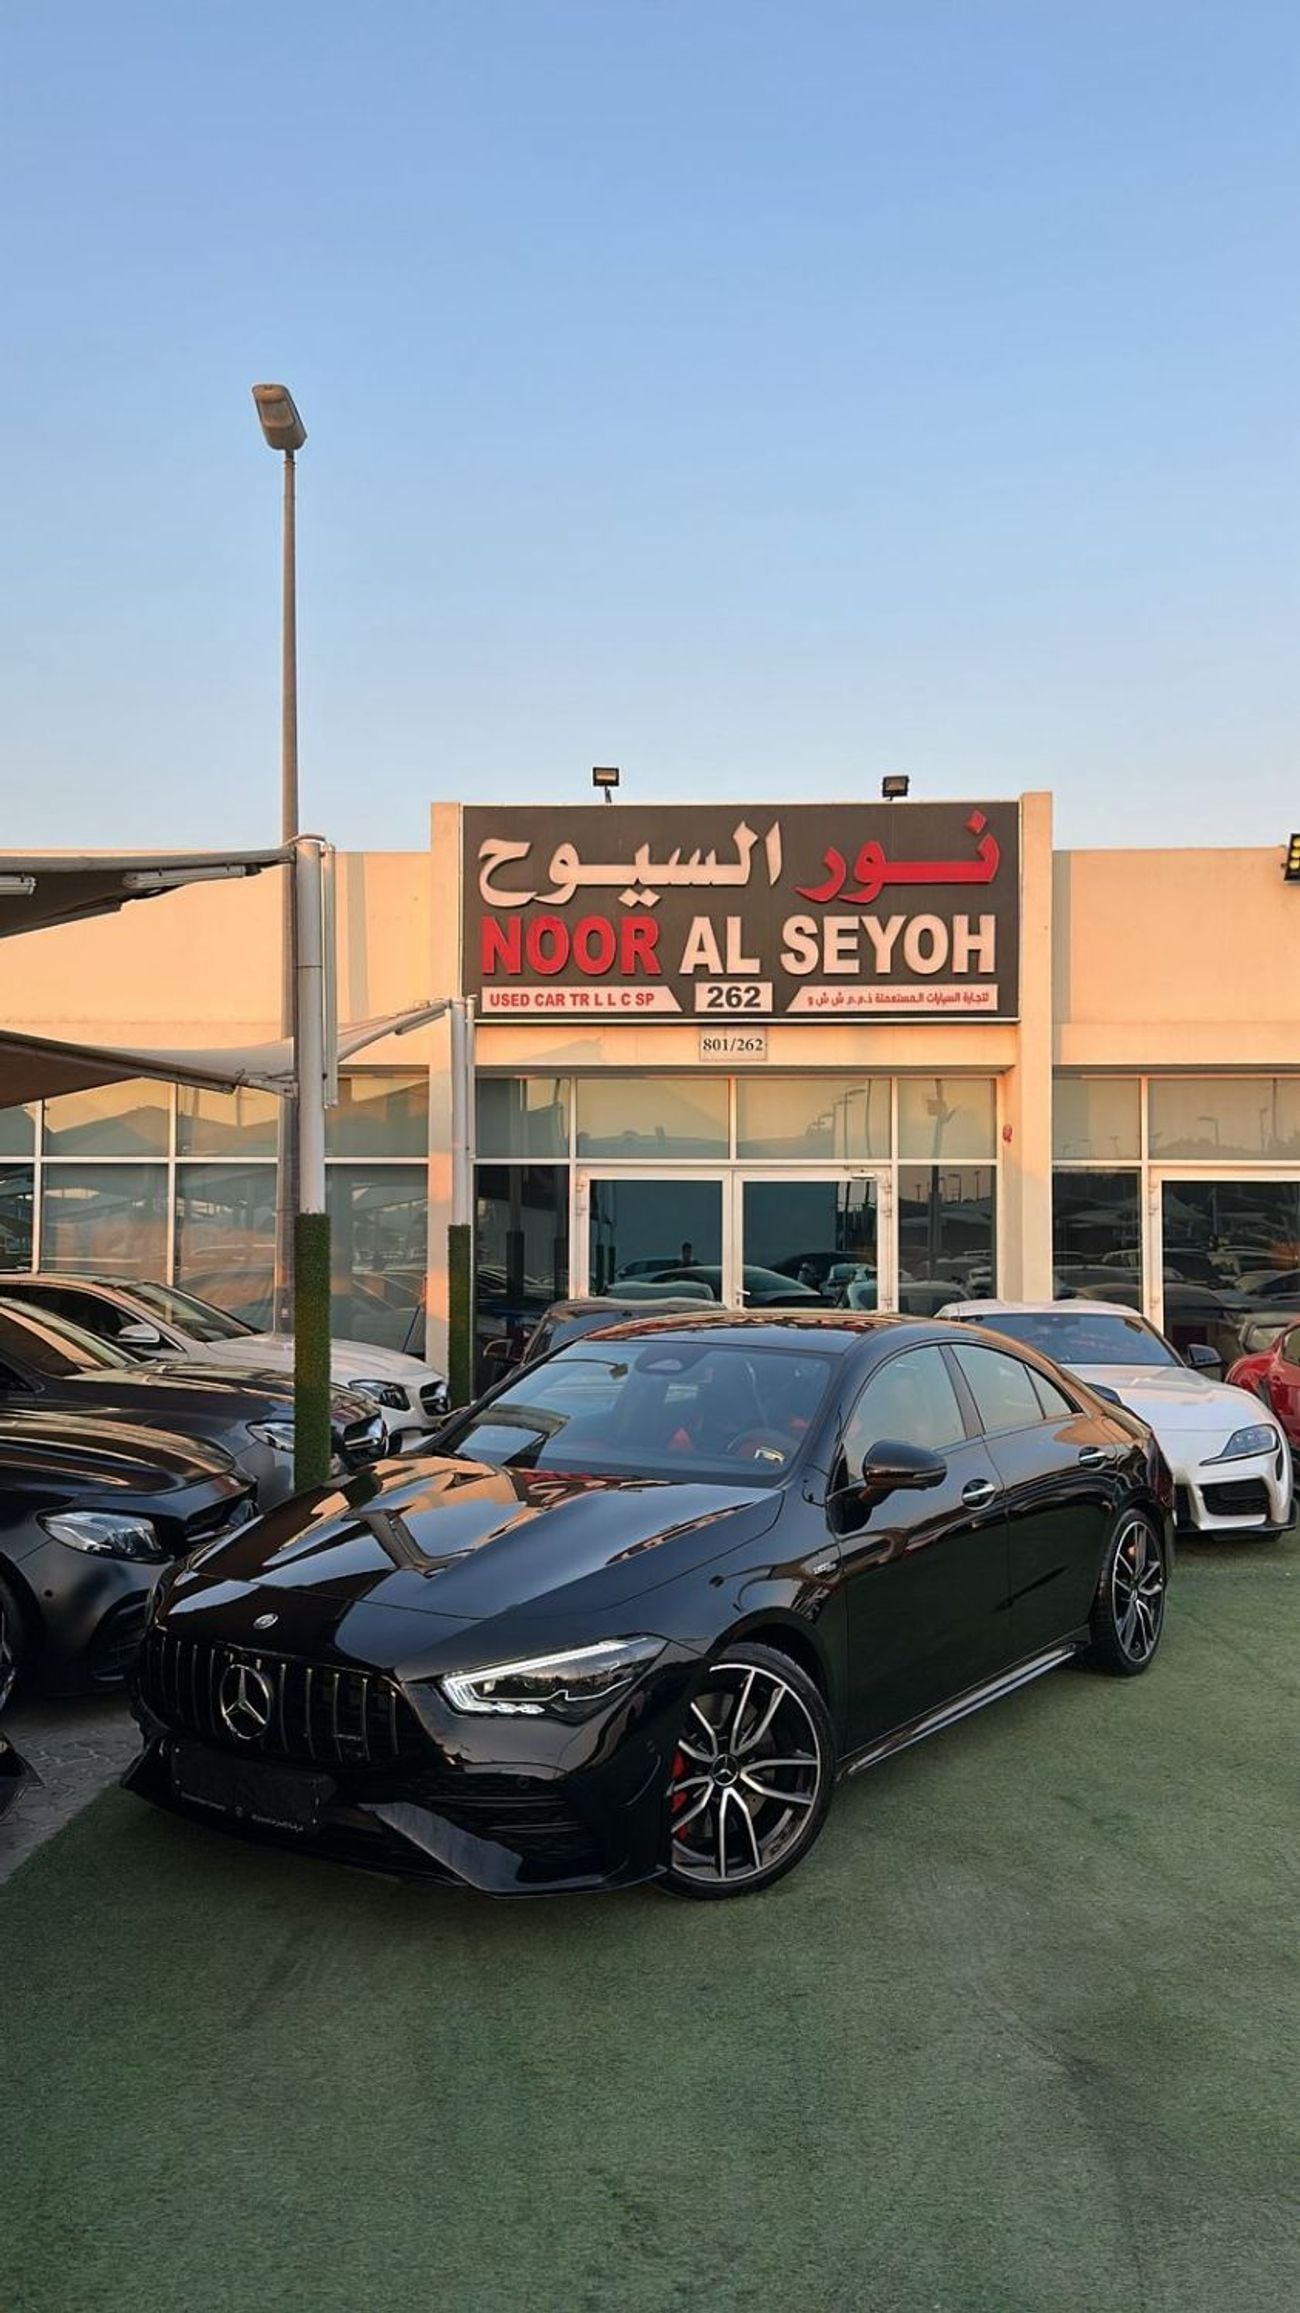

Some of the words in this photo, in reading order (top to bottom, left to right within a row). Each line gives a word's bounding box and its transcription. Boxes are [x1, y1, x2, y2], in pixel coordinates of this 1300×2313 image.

[478, 820, 782, 908] السيوح
[795, 809, 1000, 904] نور
[481, 915, 661, 975] NOOR
[679, 915, 761, 975] AL
[779, 914, 996, 976] SEYOH
[490, 993, 530, 1007] USED
[534, 993, 565, 1007] CAR
[569, 993, 589, 1007] TR
[595, 993, 603, 1006] L
[608, 993, 616, 1006] L
[620, 993, 631, 1006] C
[635, 993, 655, 1006] SP
[706, 986, 762, 1009] 262
[875, 991, 924, 1004] المستعملة
[926, 991, 961, 1006] السيارات
[703, 1038, 764, 1052] 801/262
